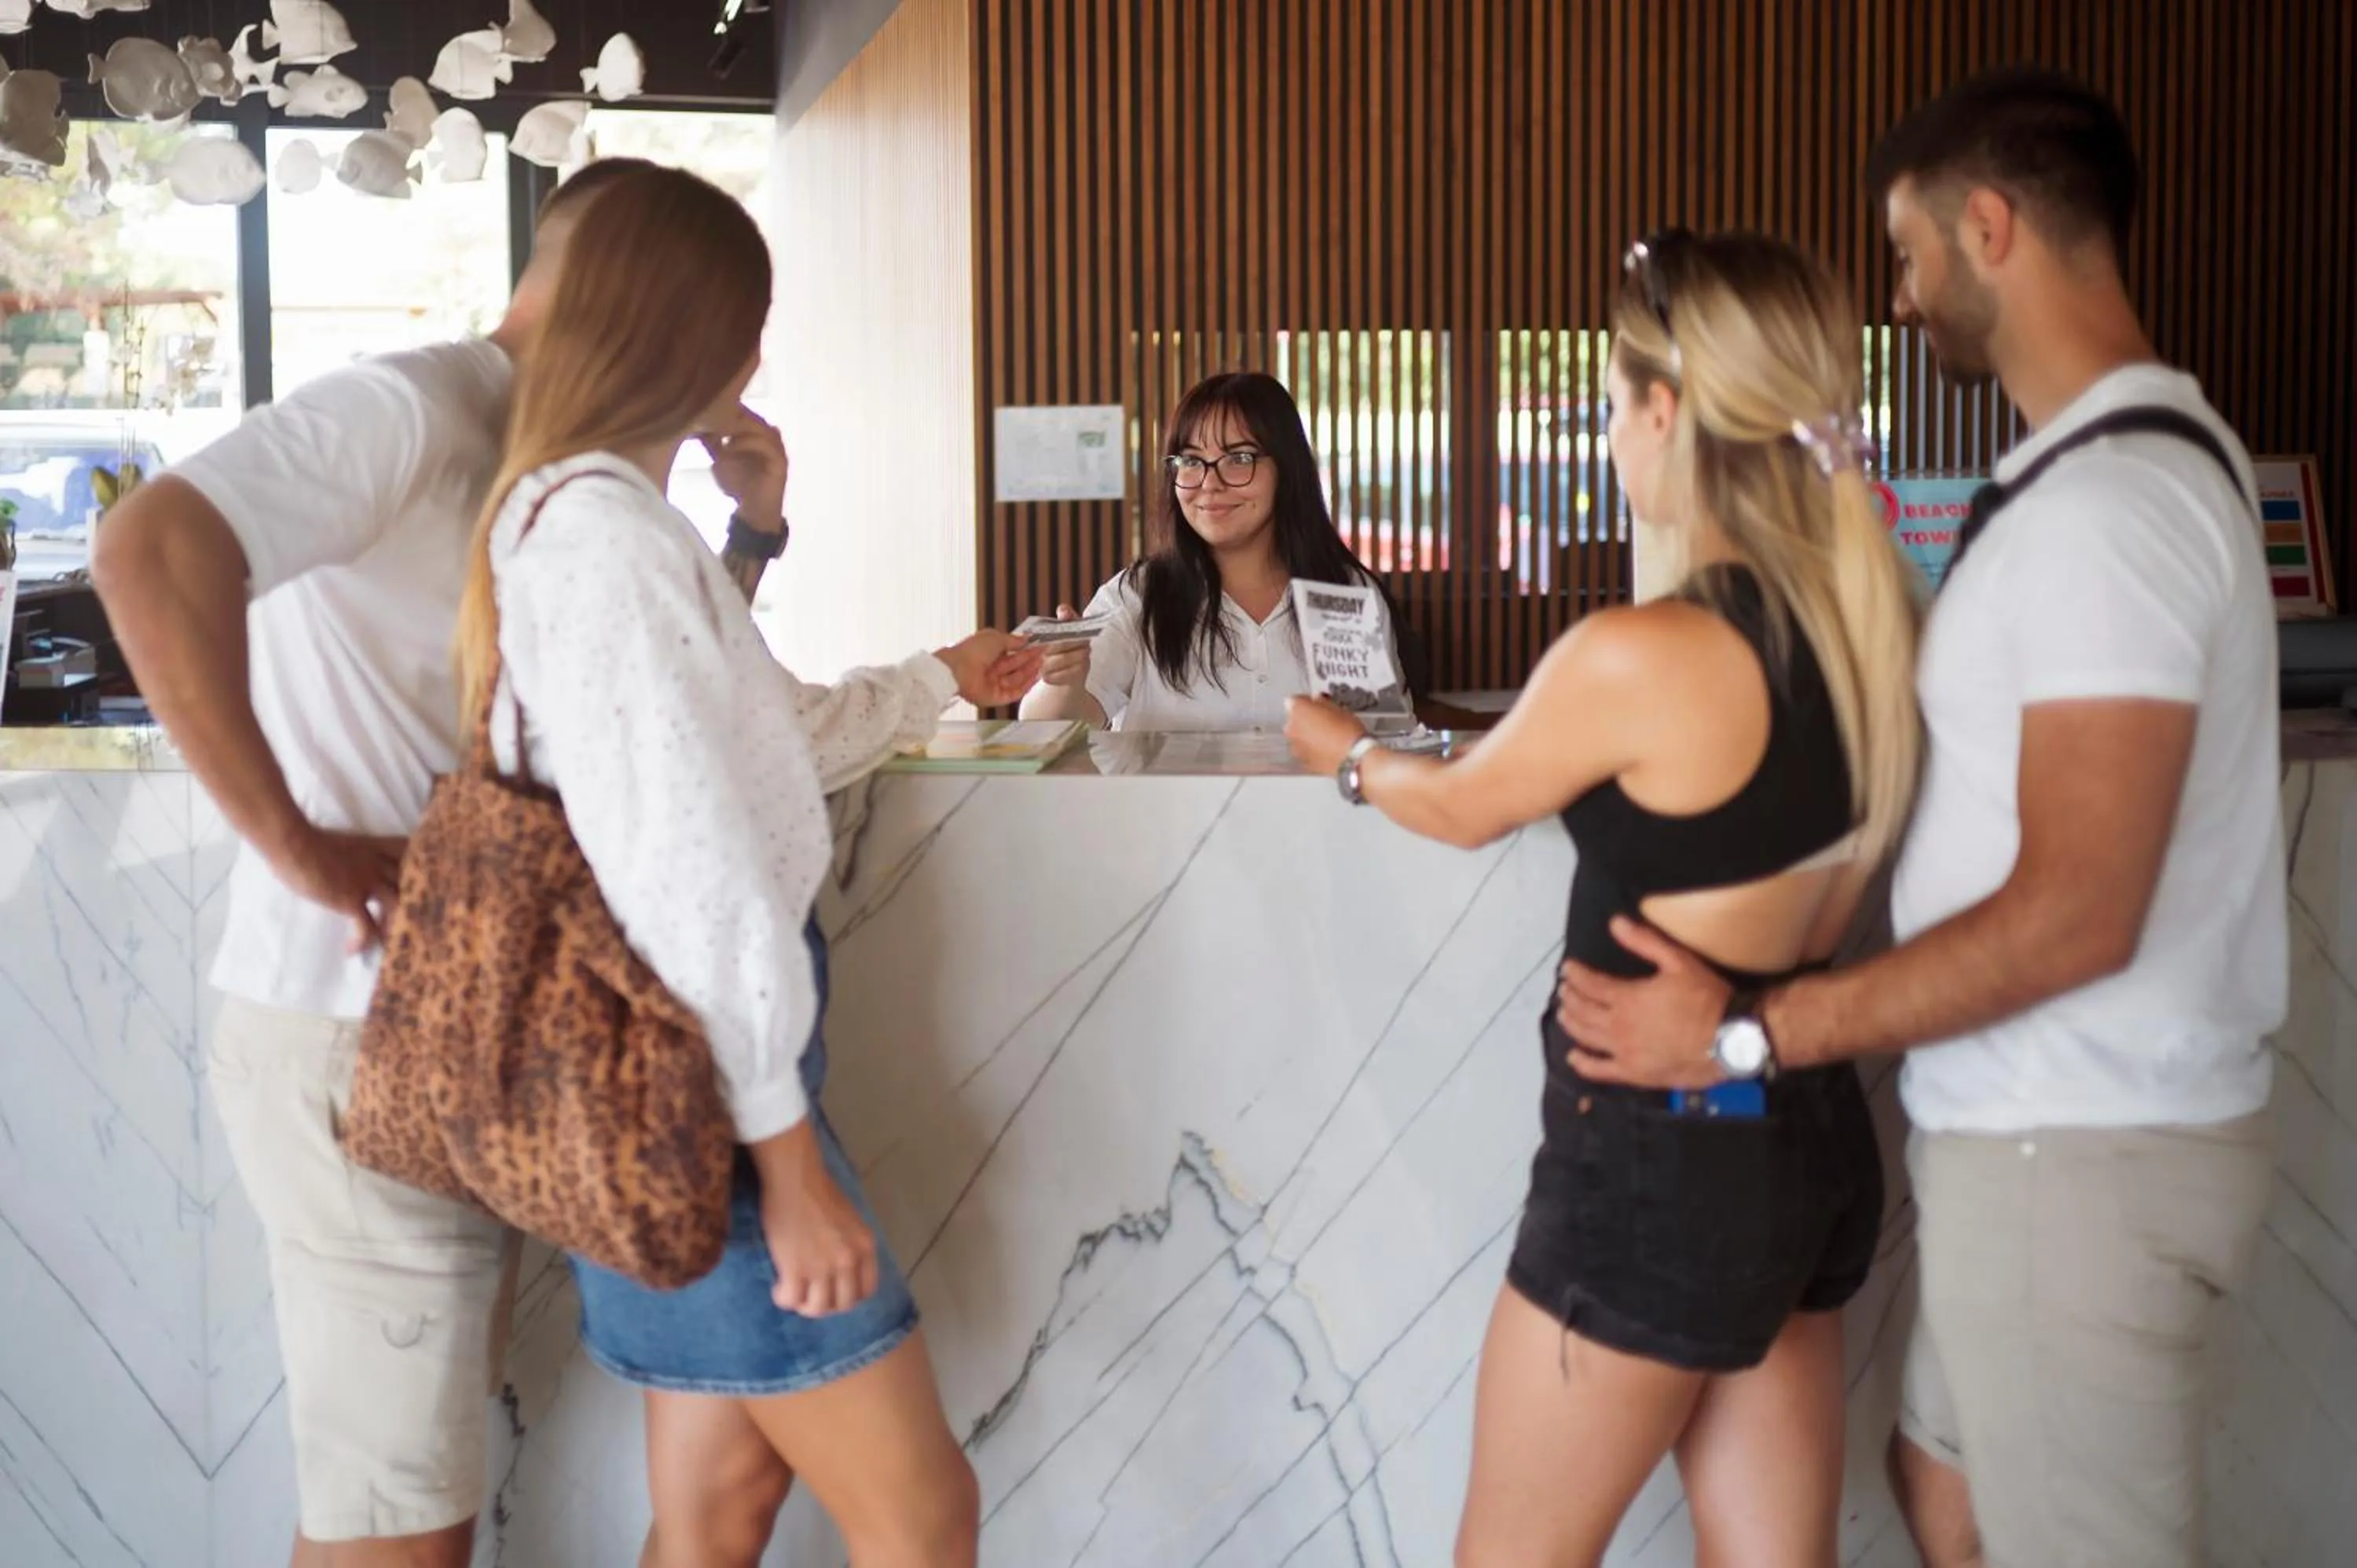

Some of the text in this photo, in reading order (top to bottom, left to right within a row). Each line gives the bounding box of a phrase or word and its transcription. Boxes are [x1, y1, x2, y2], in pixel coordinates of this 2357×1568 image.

[1904, 504, 1972, 518] BEACH
[1900, 530, 1956, 546] TOW
[1312, 642, 1369, 663] FUNKY
[1317, 661, 1369, 680] NIGHT
